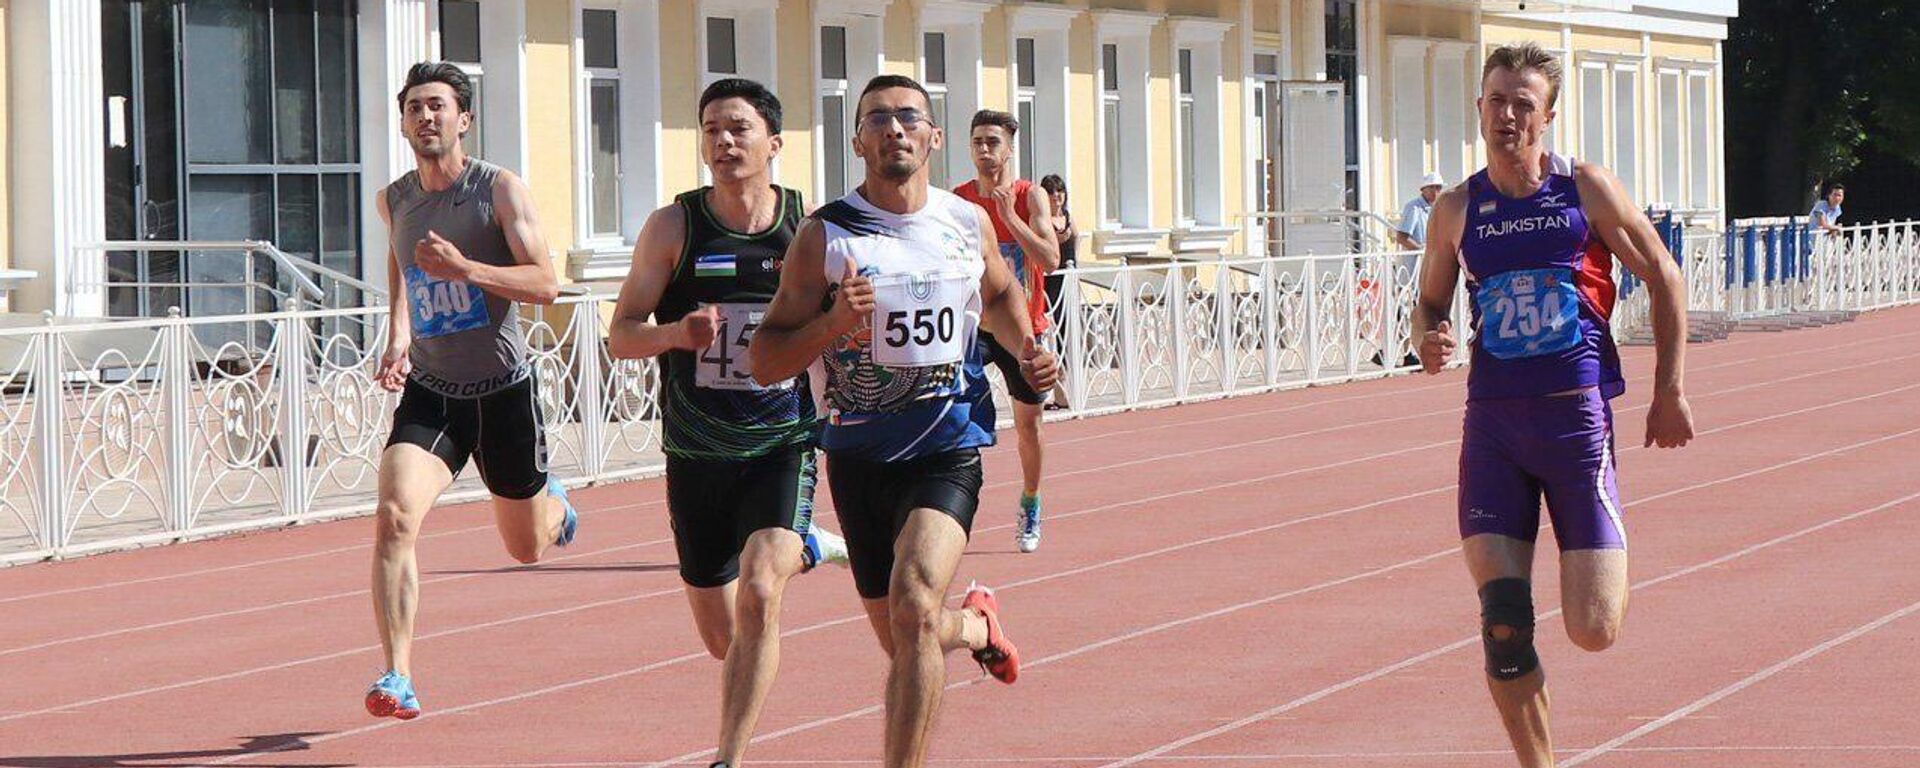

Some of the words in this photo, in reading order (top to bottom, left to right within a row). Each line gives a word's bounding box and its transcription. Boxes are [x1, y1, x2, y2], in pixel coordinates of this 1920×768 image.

[1476, 215, 1571, 239] TAJIKISTAN
[416, 280, 472, 321] 340
[1495, 292, 1564, 339] 254
[885, 306, 955, 348] 550
[421, 373, 459, 396] PRO
